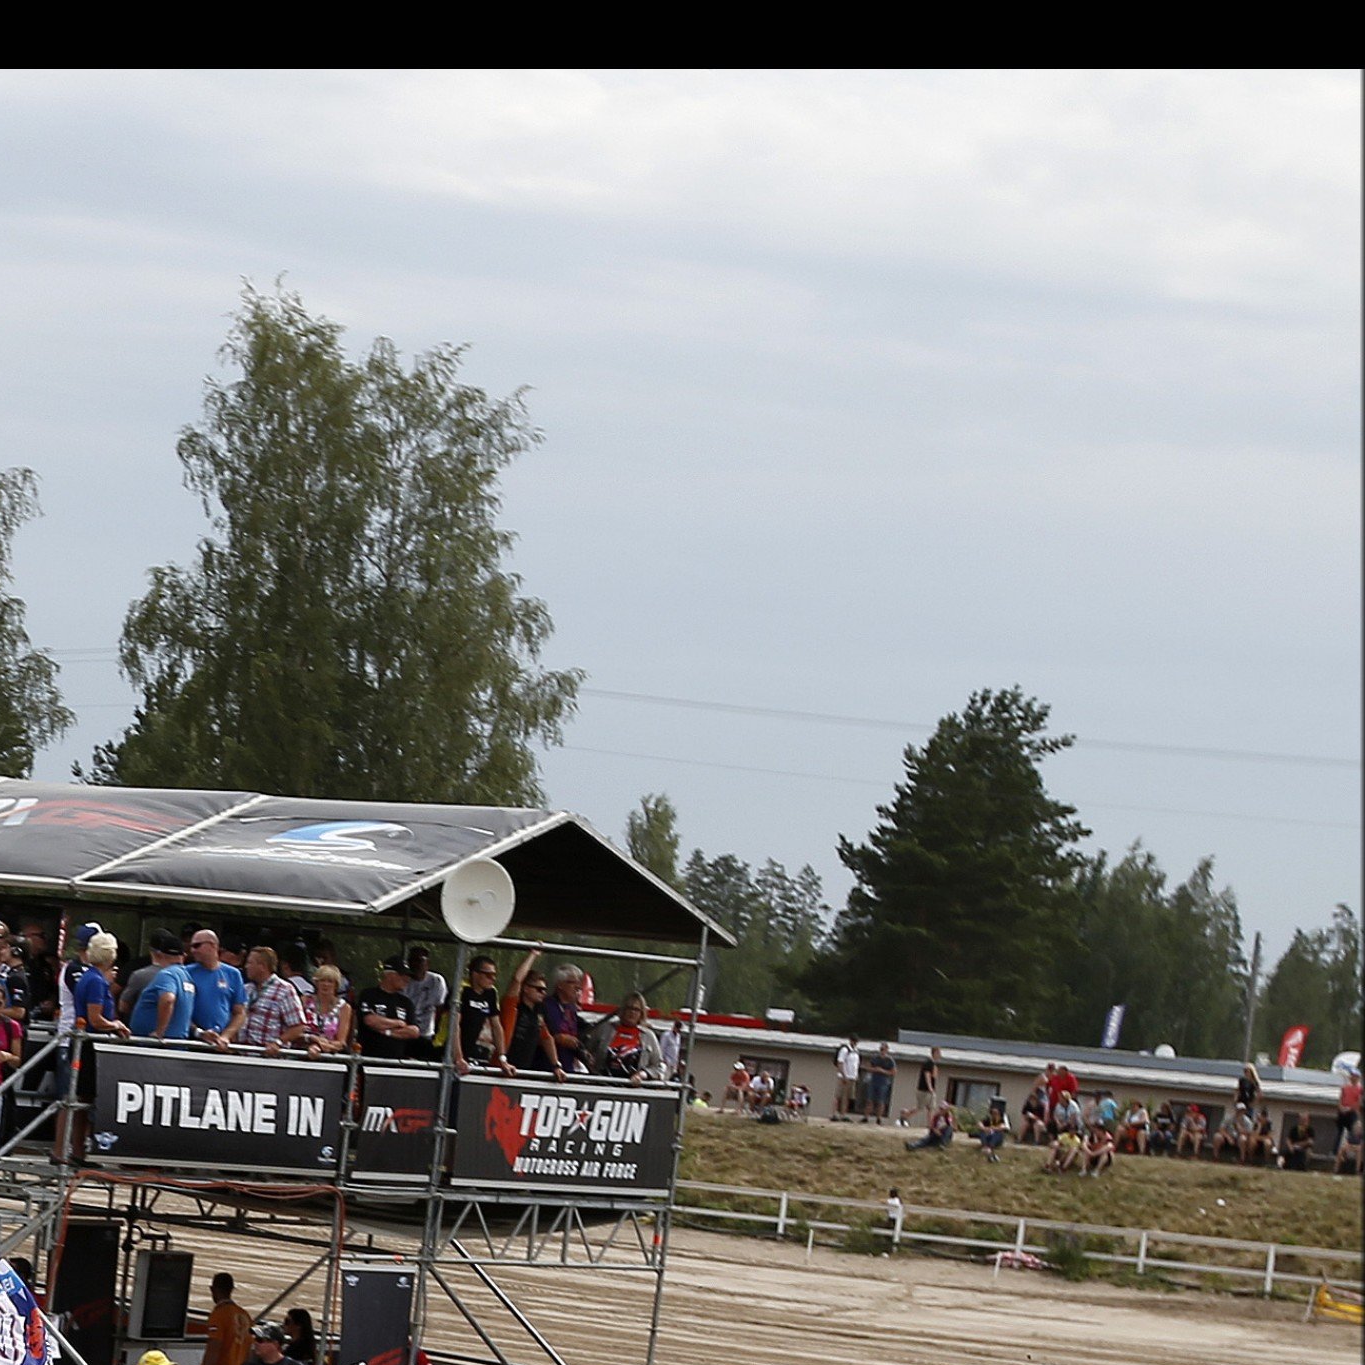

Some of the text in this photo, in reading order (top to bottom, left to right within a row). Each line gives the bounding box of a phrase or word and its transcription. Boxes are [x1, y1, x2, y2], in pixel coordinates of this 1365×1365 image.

[117, 1082, 325, 1138] PITLANE IN
[519, 1093, 649, 1144] TOP GUN
[513, 1155, 638, 1180] MOTOCROSS AIR FORCE
[529, 1139, 623, 1158] RACING
